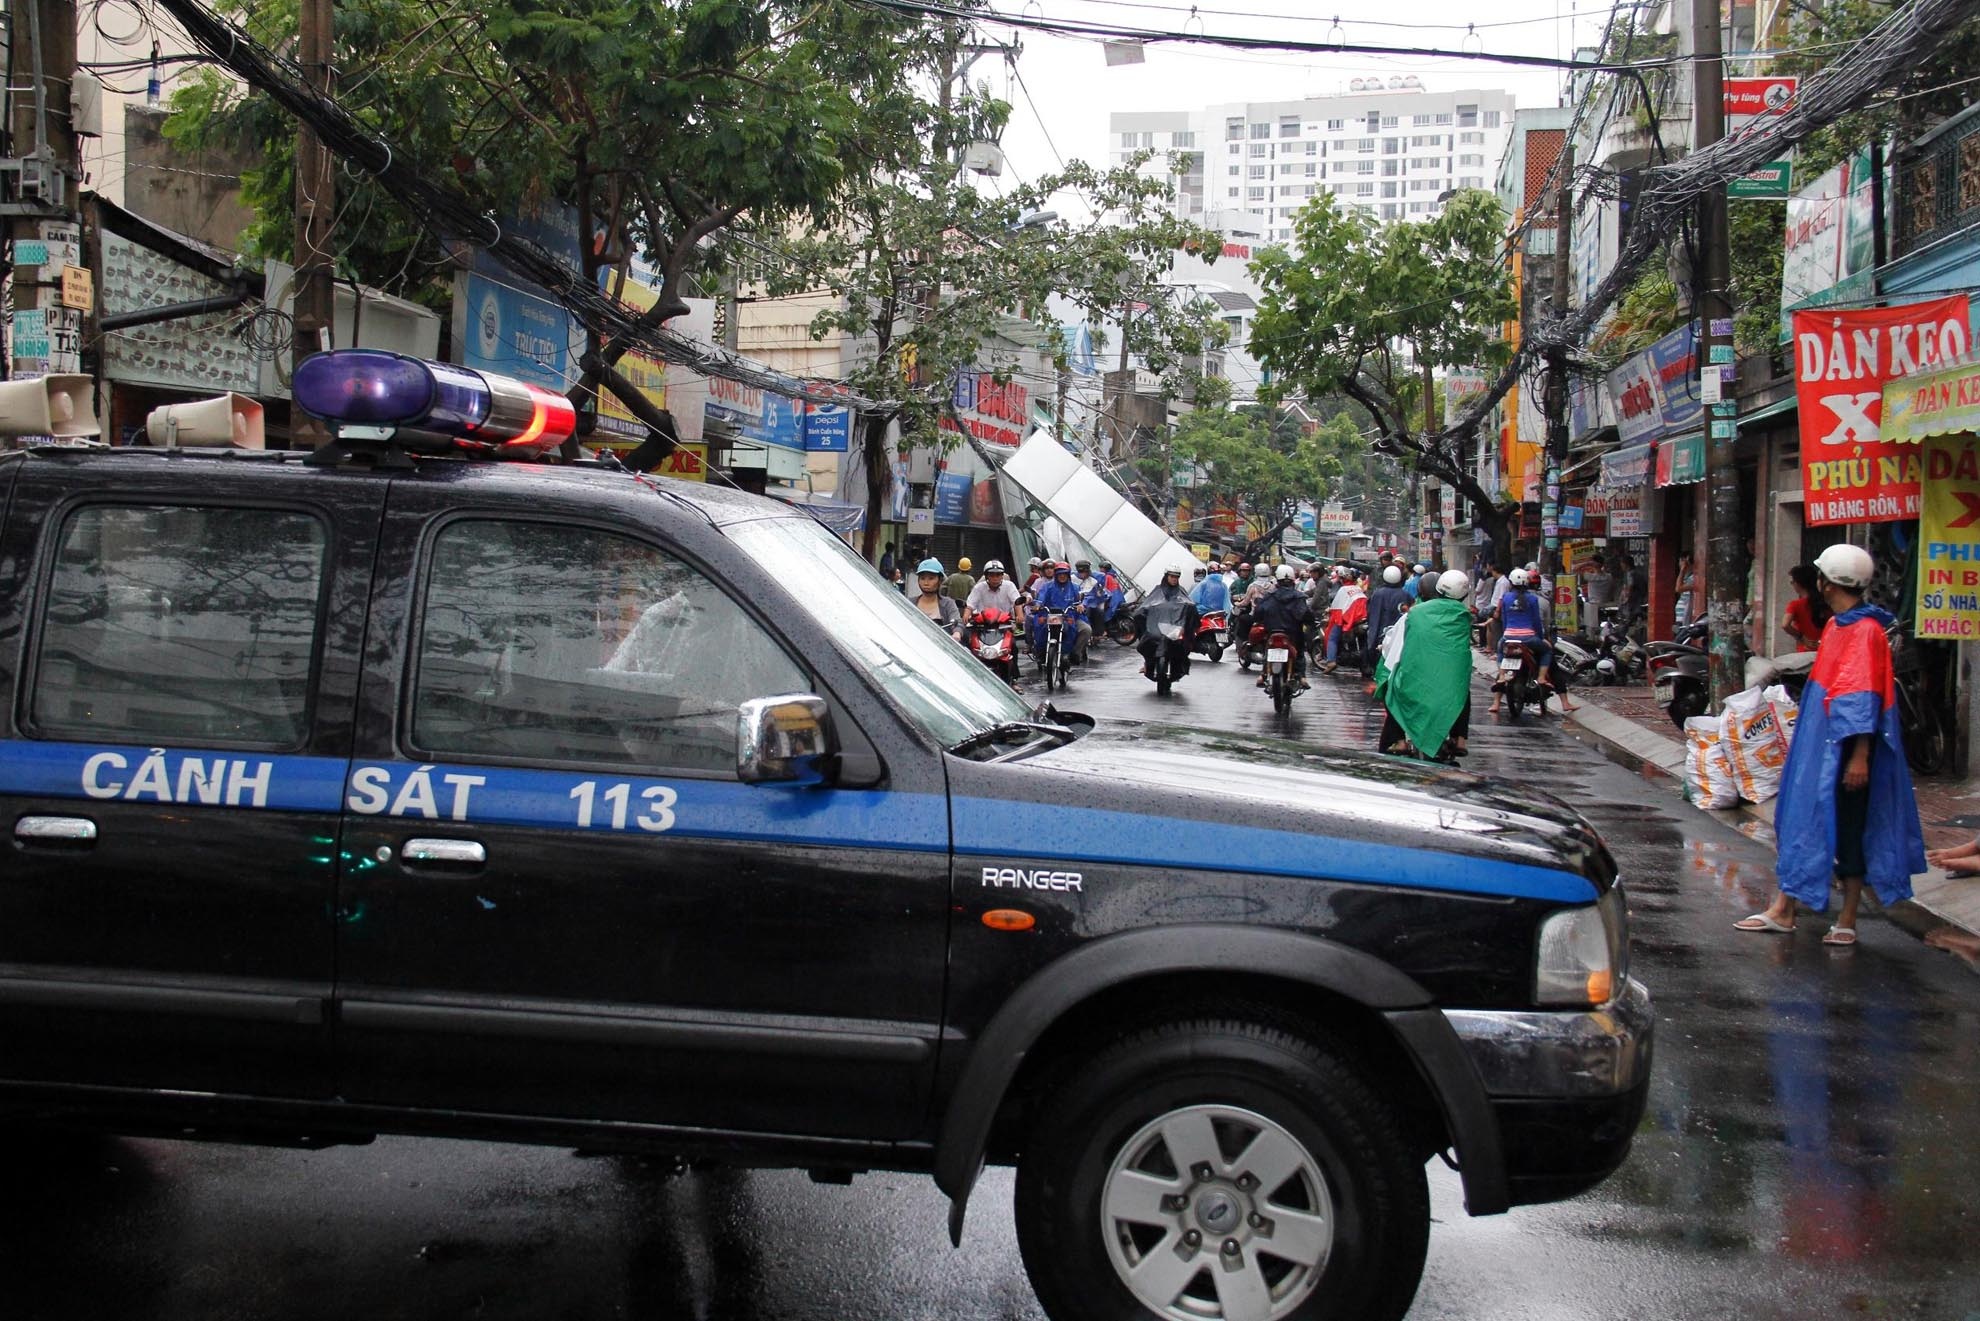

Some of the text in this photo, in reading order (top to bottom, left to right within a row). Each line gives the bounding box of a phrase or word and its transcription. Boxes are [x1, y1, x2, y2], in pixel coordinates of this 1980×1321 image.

[1741, 92, 1760, 103] tùng
[1914, 376, 1953, 415] DÁN
[767, 402, 778, 428] 25
[815, 416, 838, 425] pepsi
[821, 436, 831, 446] 25
[669, 450, 702, 474] XE
[1808, 445, 1871, 491] PHỦ
[1810, 502, 1825, 521] IN
[1828, 497, 1866, 519] BĂNG
[1929, 569, 1953, 586] IN
[1923, 588, 1944, 609] SỐ
[1924, 612, 1972, 635] KHẮC
[82, 747, 678, 832] CẢNH SÁT 113
[982, 867, 1083, 892] RANGER
